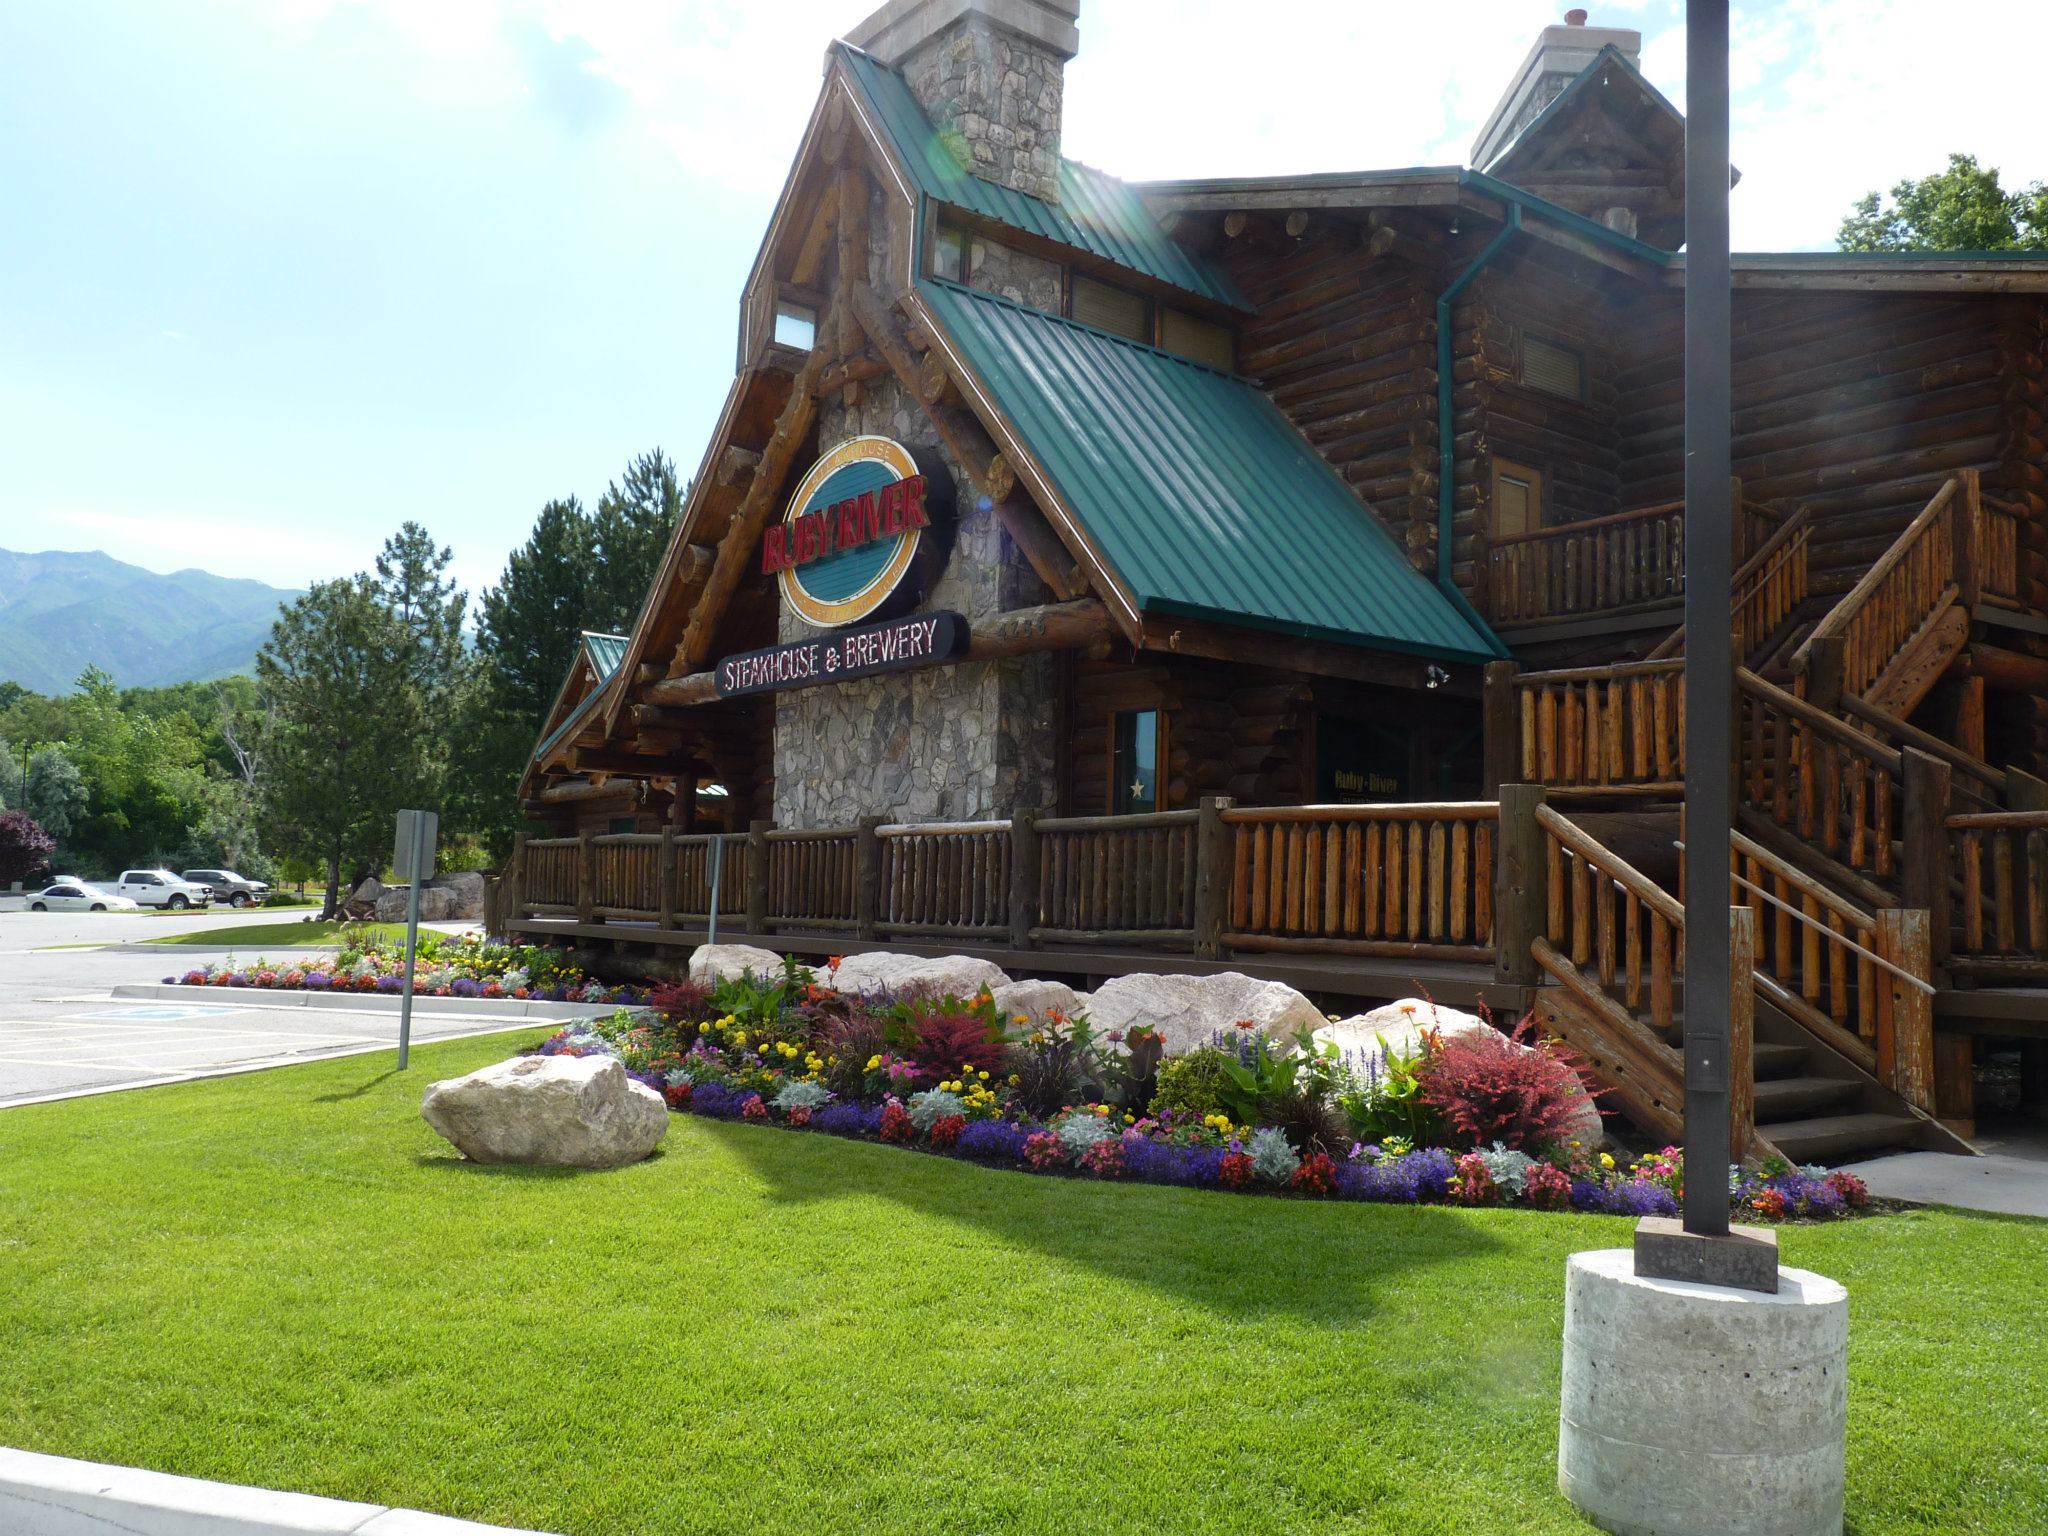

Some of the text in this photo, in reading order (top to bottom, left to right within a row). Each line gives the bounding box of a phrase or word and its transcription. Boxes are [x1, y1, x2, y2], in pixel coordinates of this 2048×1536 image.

[761, 474, 929, 576] RUBY RIVER
[724, 619, 937, 691] STEAKHOUSE & BREWERY
